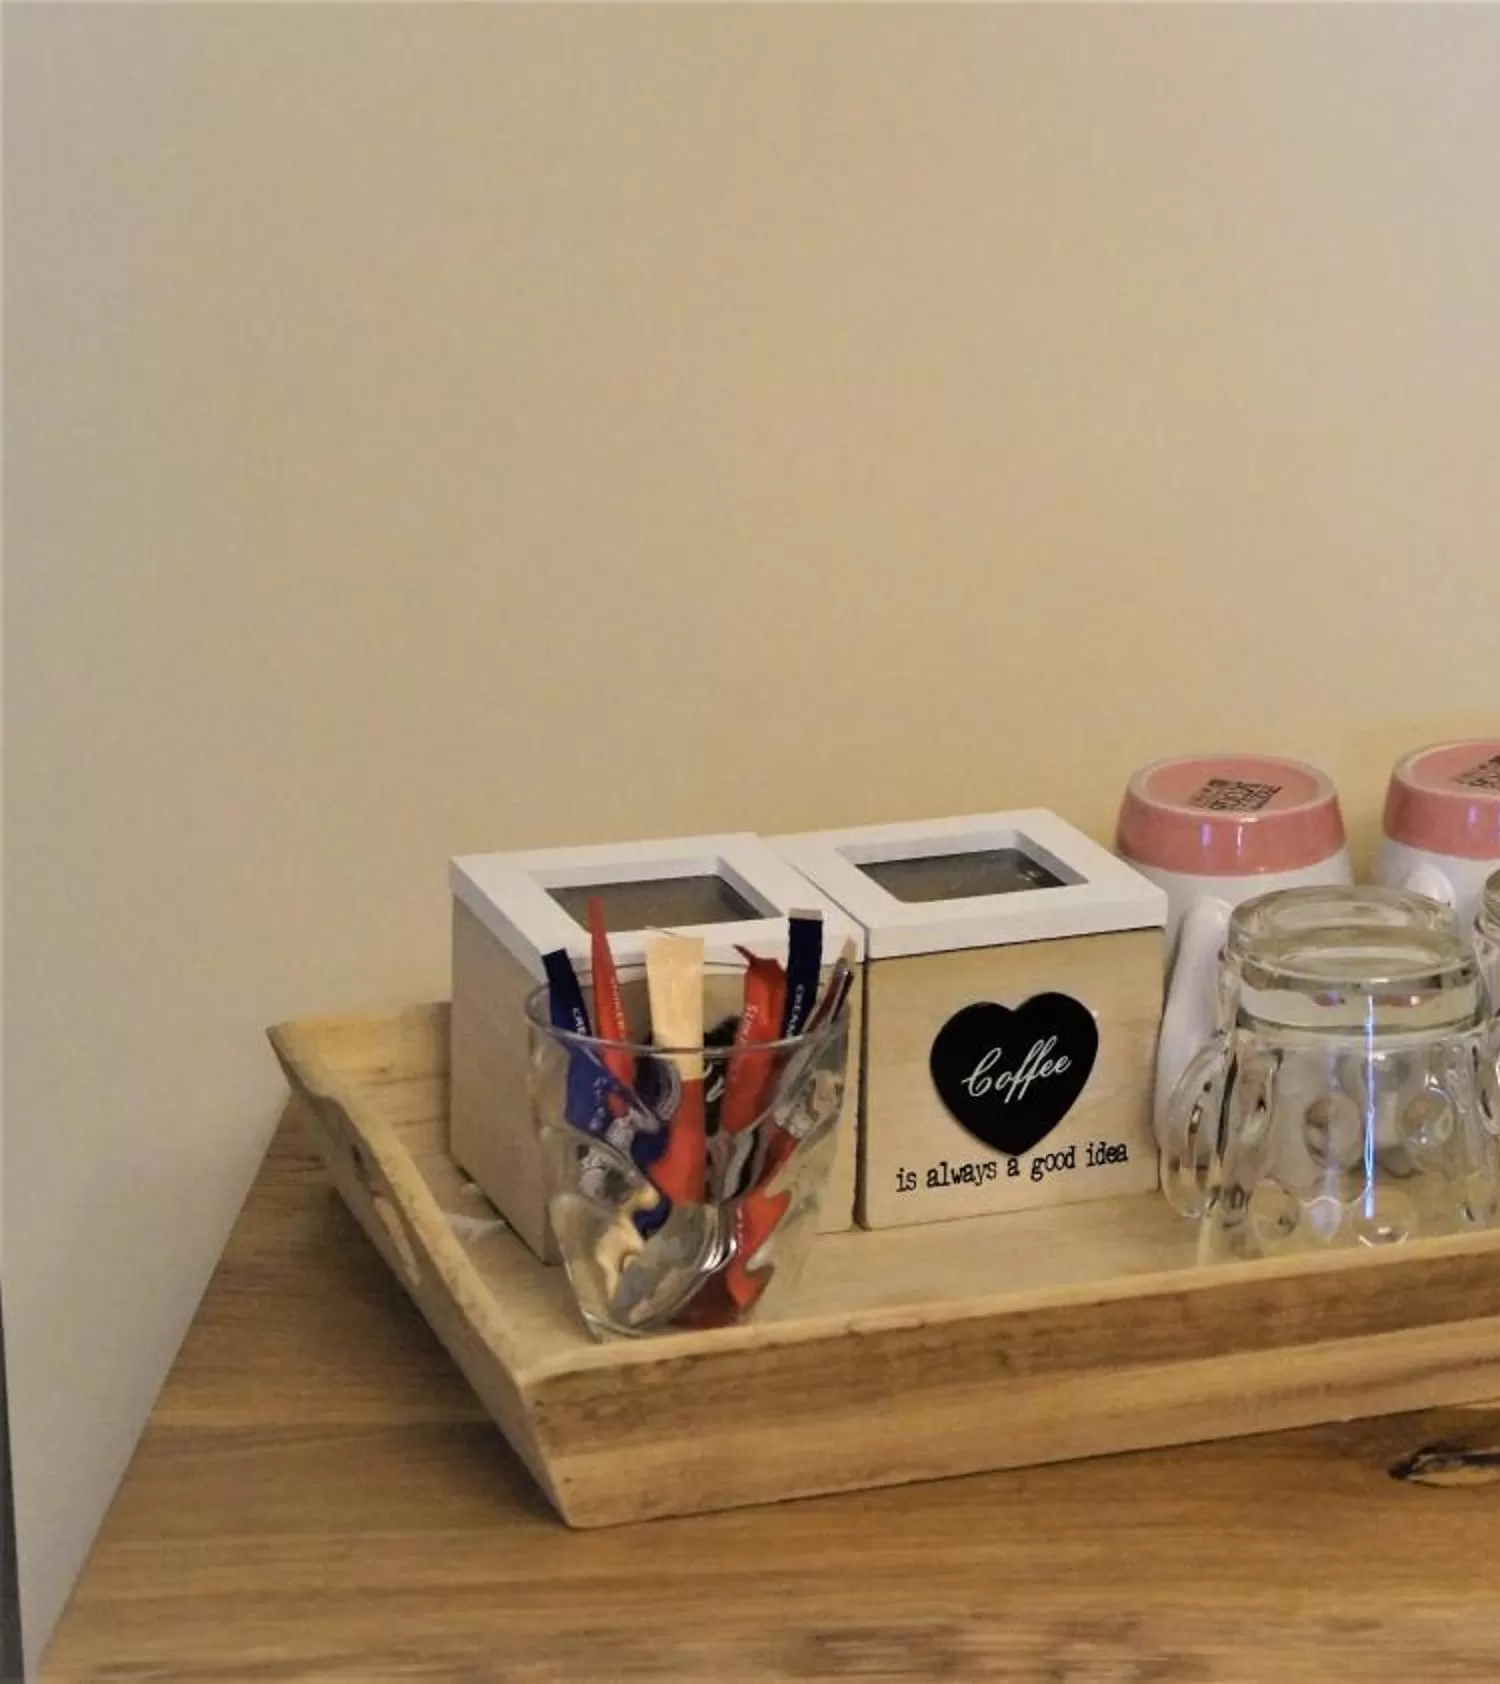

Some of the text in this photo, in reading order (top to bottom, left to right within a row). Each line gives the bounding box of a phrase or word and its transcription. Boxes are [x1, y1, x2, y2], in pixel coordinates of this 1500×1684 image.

[961, 1035, 1072, 1104] Coffee
[895, 1142, 1129, 1193] is always a good idea
